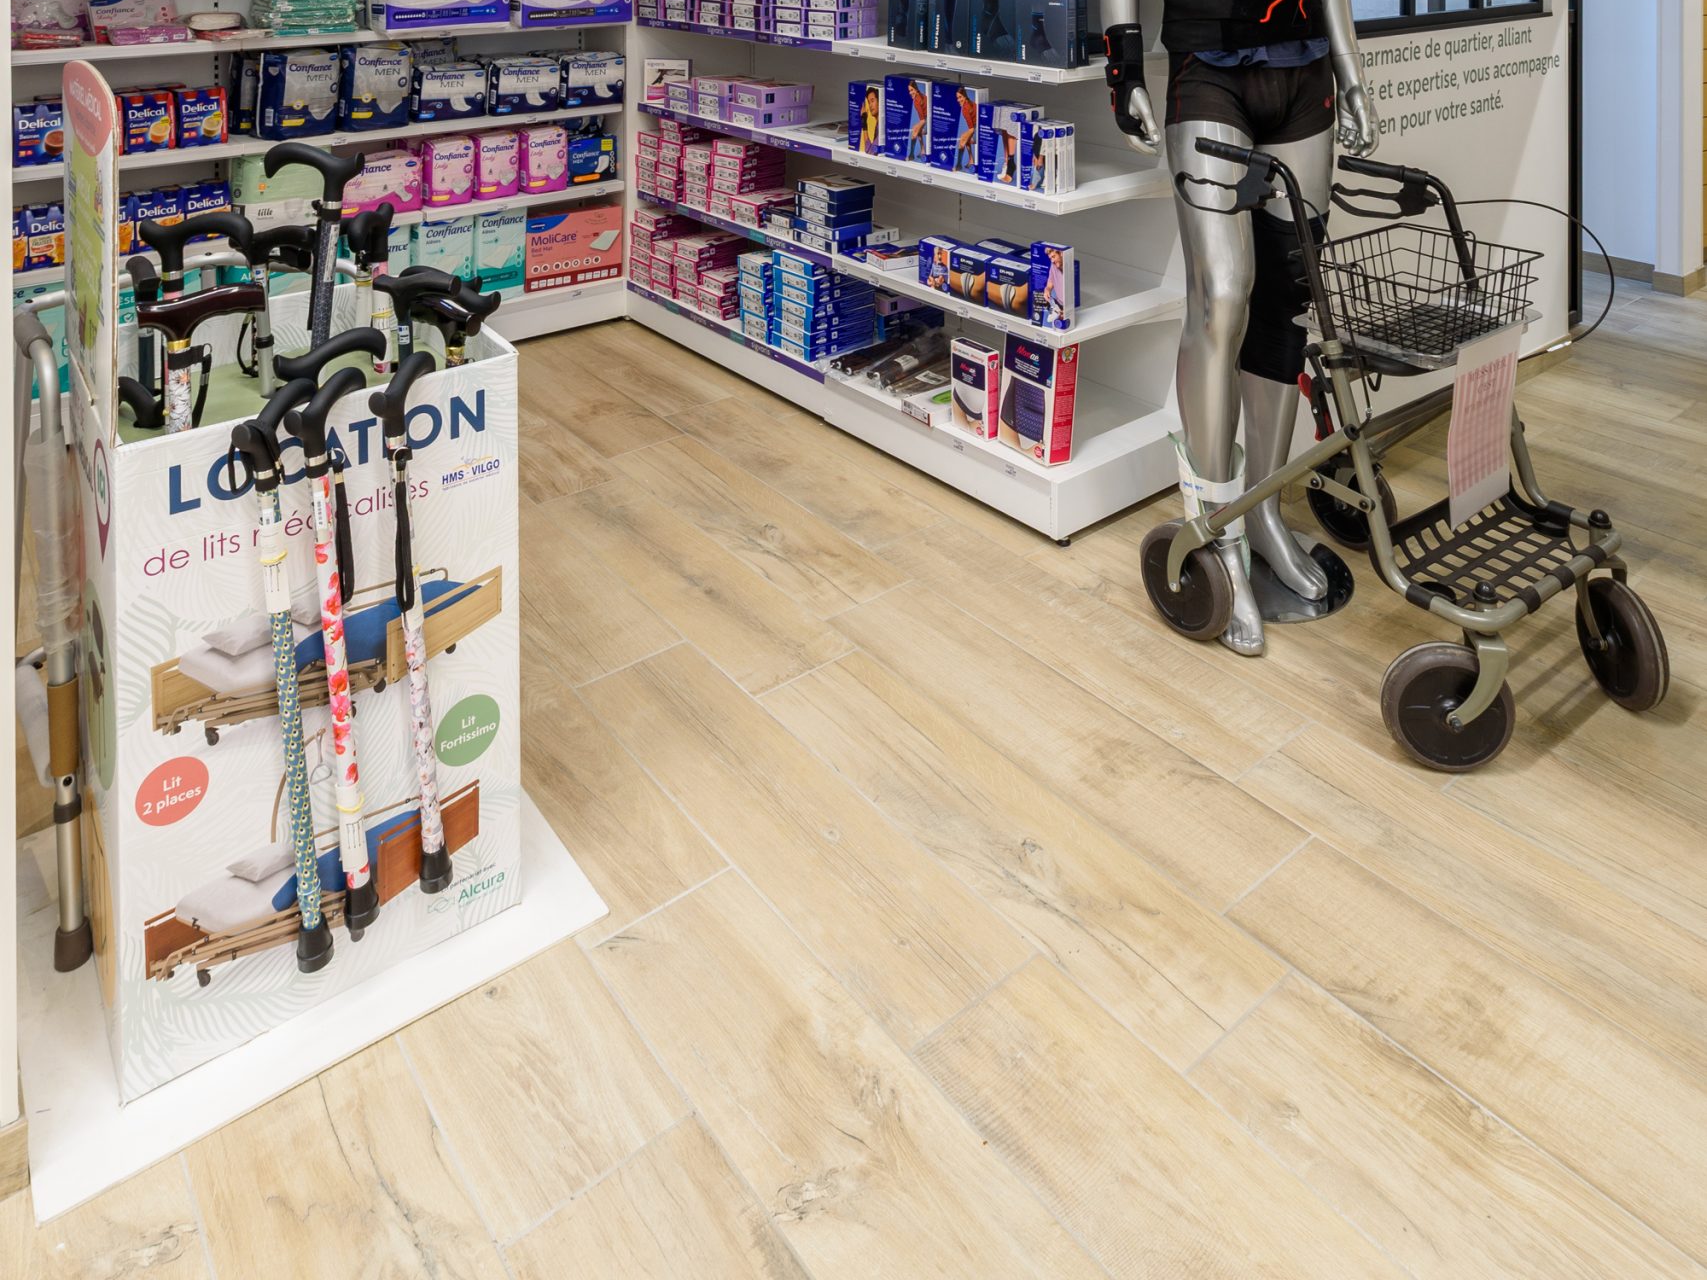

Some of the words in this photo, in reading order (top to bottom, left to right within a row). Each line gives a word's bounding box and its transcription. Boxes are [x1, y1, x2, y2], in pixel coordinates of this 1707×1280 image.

[1361, 41, 1421, 68] armacie
[1425, 38, 1440, 58] de
[1445, 34, 1494, 60] quartier,
[1498, 27, 1532, 48] alliant
[289, 62, 333, 73] Confiance
[358, 56, 402, 68] Confiance
[571, 61, 607, 71] Confiance
[375, 67, 400, 76] MEN
[425, 71, 466, 82] Confiance
[502, 67, 540, 77] Confiance
[585, 67, 607, 76] MEN
[1379, 82, 1393, 100] et
[1397, 70, 1460, 100] expertise,
[1463, 64, 1490, 85] vous
[1493, 52, 1560, 78] accompagne
[306, 74, 333, 82] MEN
[440, 80, 465, 88] MEN
[516, 75, 539, 83] MEN
[129, 107, 165, 119] Delical
[182, 102, 217, 113] Delical
[1400, 110, 1431, 136] pour
[1435, 99, 1467, 122] votre
[1470, 90, 1504, 115] santé.
[19, 117, 61, 129] Delical
[530, 139, 561, 149] Confiance
[770, 135, 790, 148] sigvaris
[482, 144, 514, 154] Confiance
[434, 152, 469, 161] Confiance
[572, 151, 599, 160] Confiance
[361, 164, 392, 175] fiance
[188, 196, 224, 209] Delical
[138, 204, 177, 217] Delical
[257, 208, 273, 217] lille
[31, 221, 64, 233] Delic
[482, 215, 524, 228] Confiance
[426, 224, 472, 238] Confiance
[531, 232, 577, 247] MoliCare
[168, 389, 485, 515] LOCATON
[442, 470, 464, 485] HMS
[472, 459, 500, 476] VILGO
[143, 548, 190, 577] de
[203, 531, 241, 562] lits
[461, 714, 476, 731] Lit
[440, 720, 496, 752] Fortissimo
[163, 775, 183, 792] Lit
[143, 802, 153, 816] 2
[156, 784, 202, 812] places
[458, 872, 505, 903] Alcura
